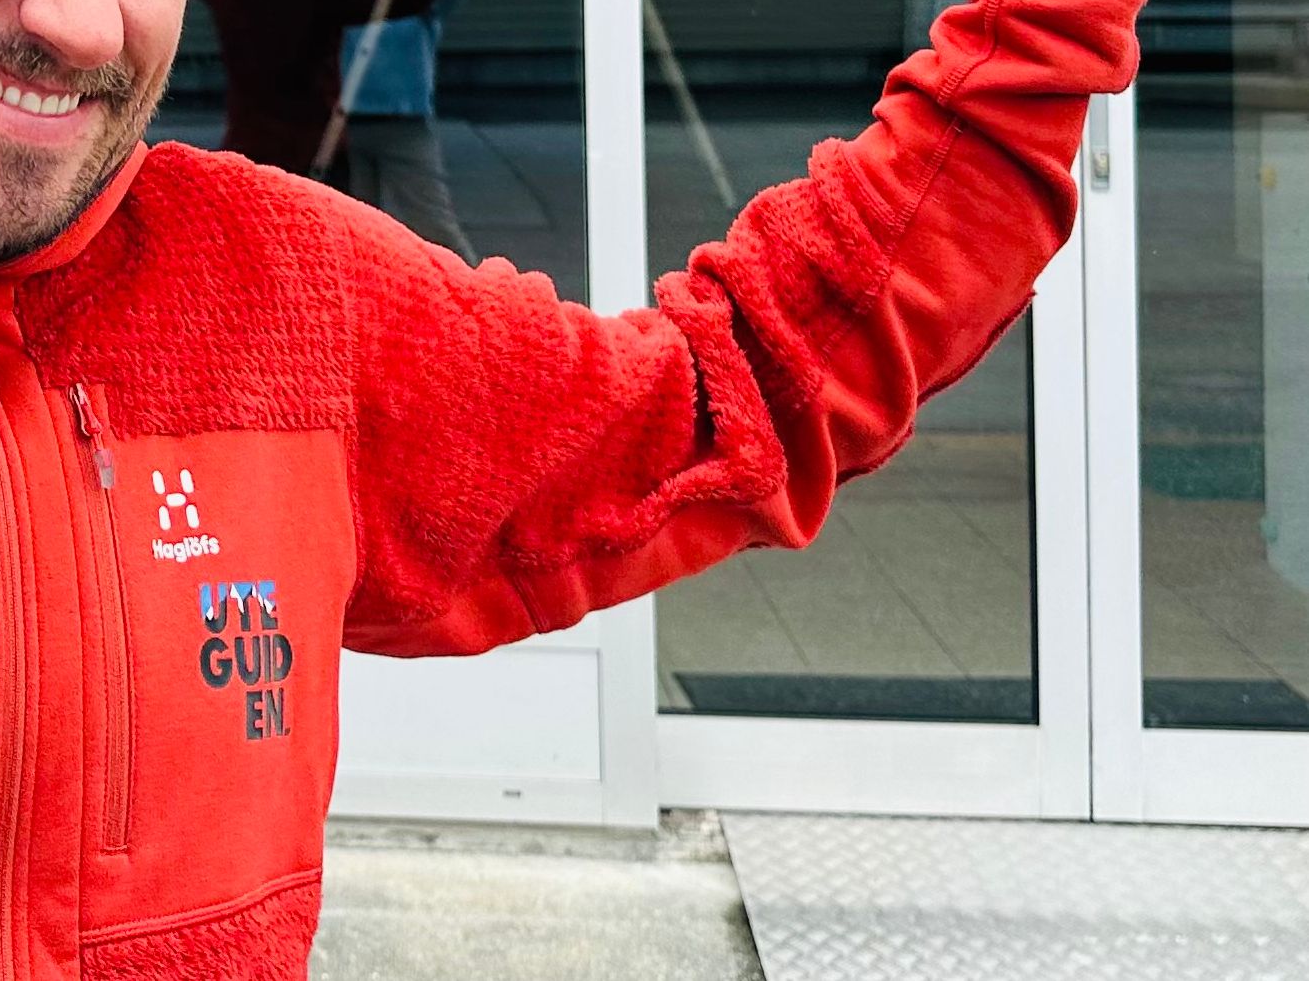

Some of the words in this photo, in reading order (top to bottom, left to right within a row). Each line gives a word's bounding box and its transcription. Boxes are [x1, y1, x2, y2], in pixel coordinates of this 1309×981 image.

[152, 534, 220, 563] Haglöfs
[198, 580, 279, 634] UTE
[199, 633, 293, 689] GUID
